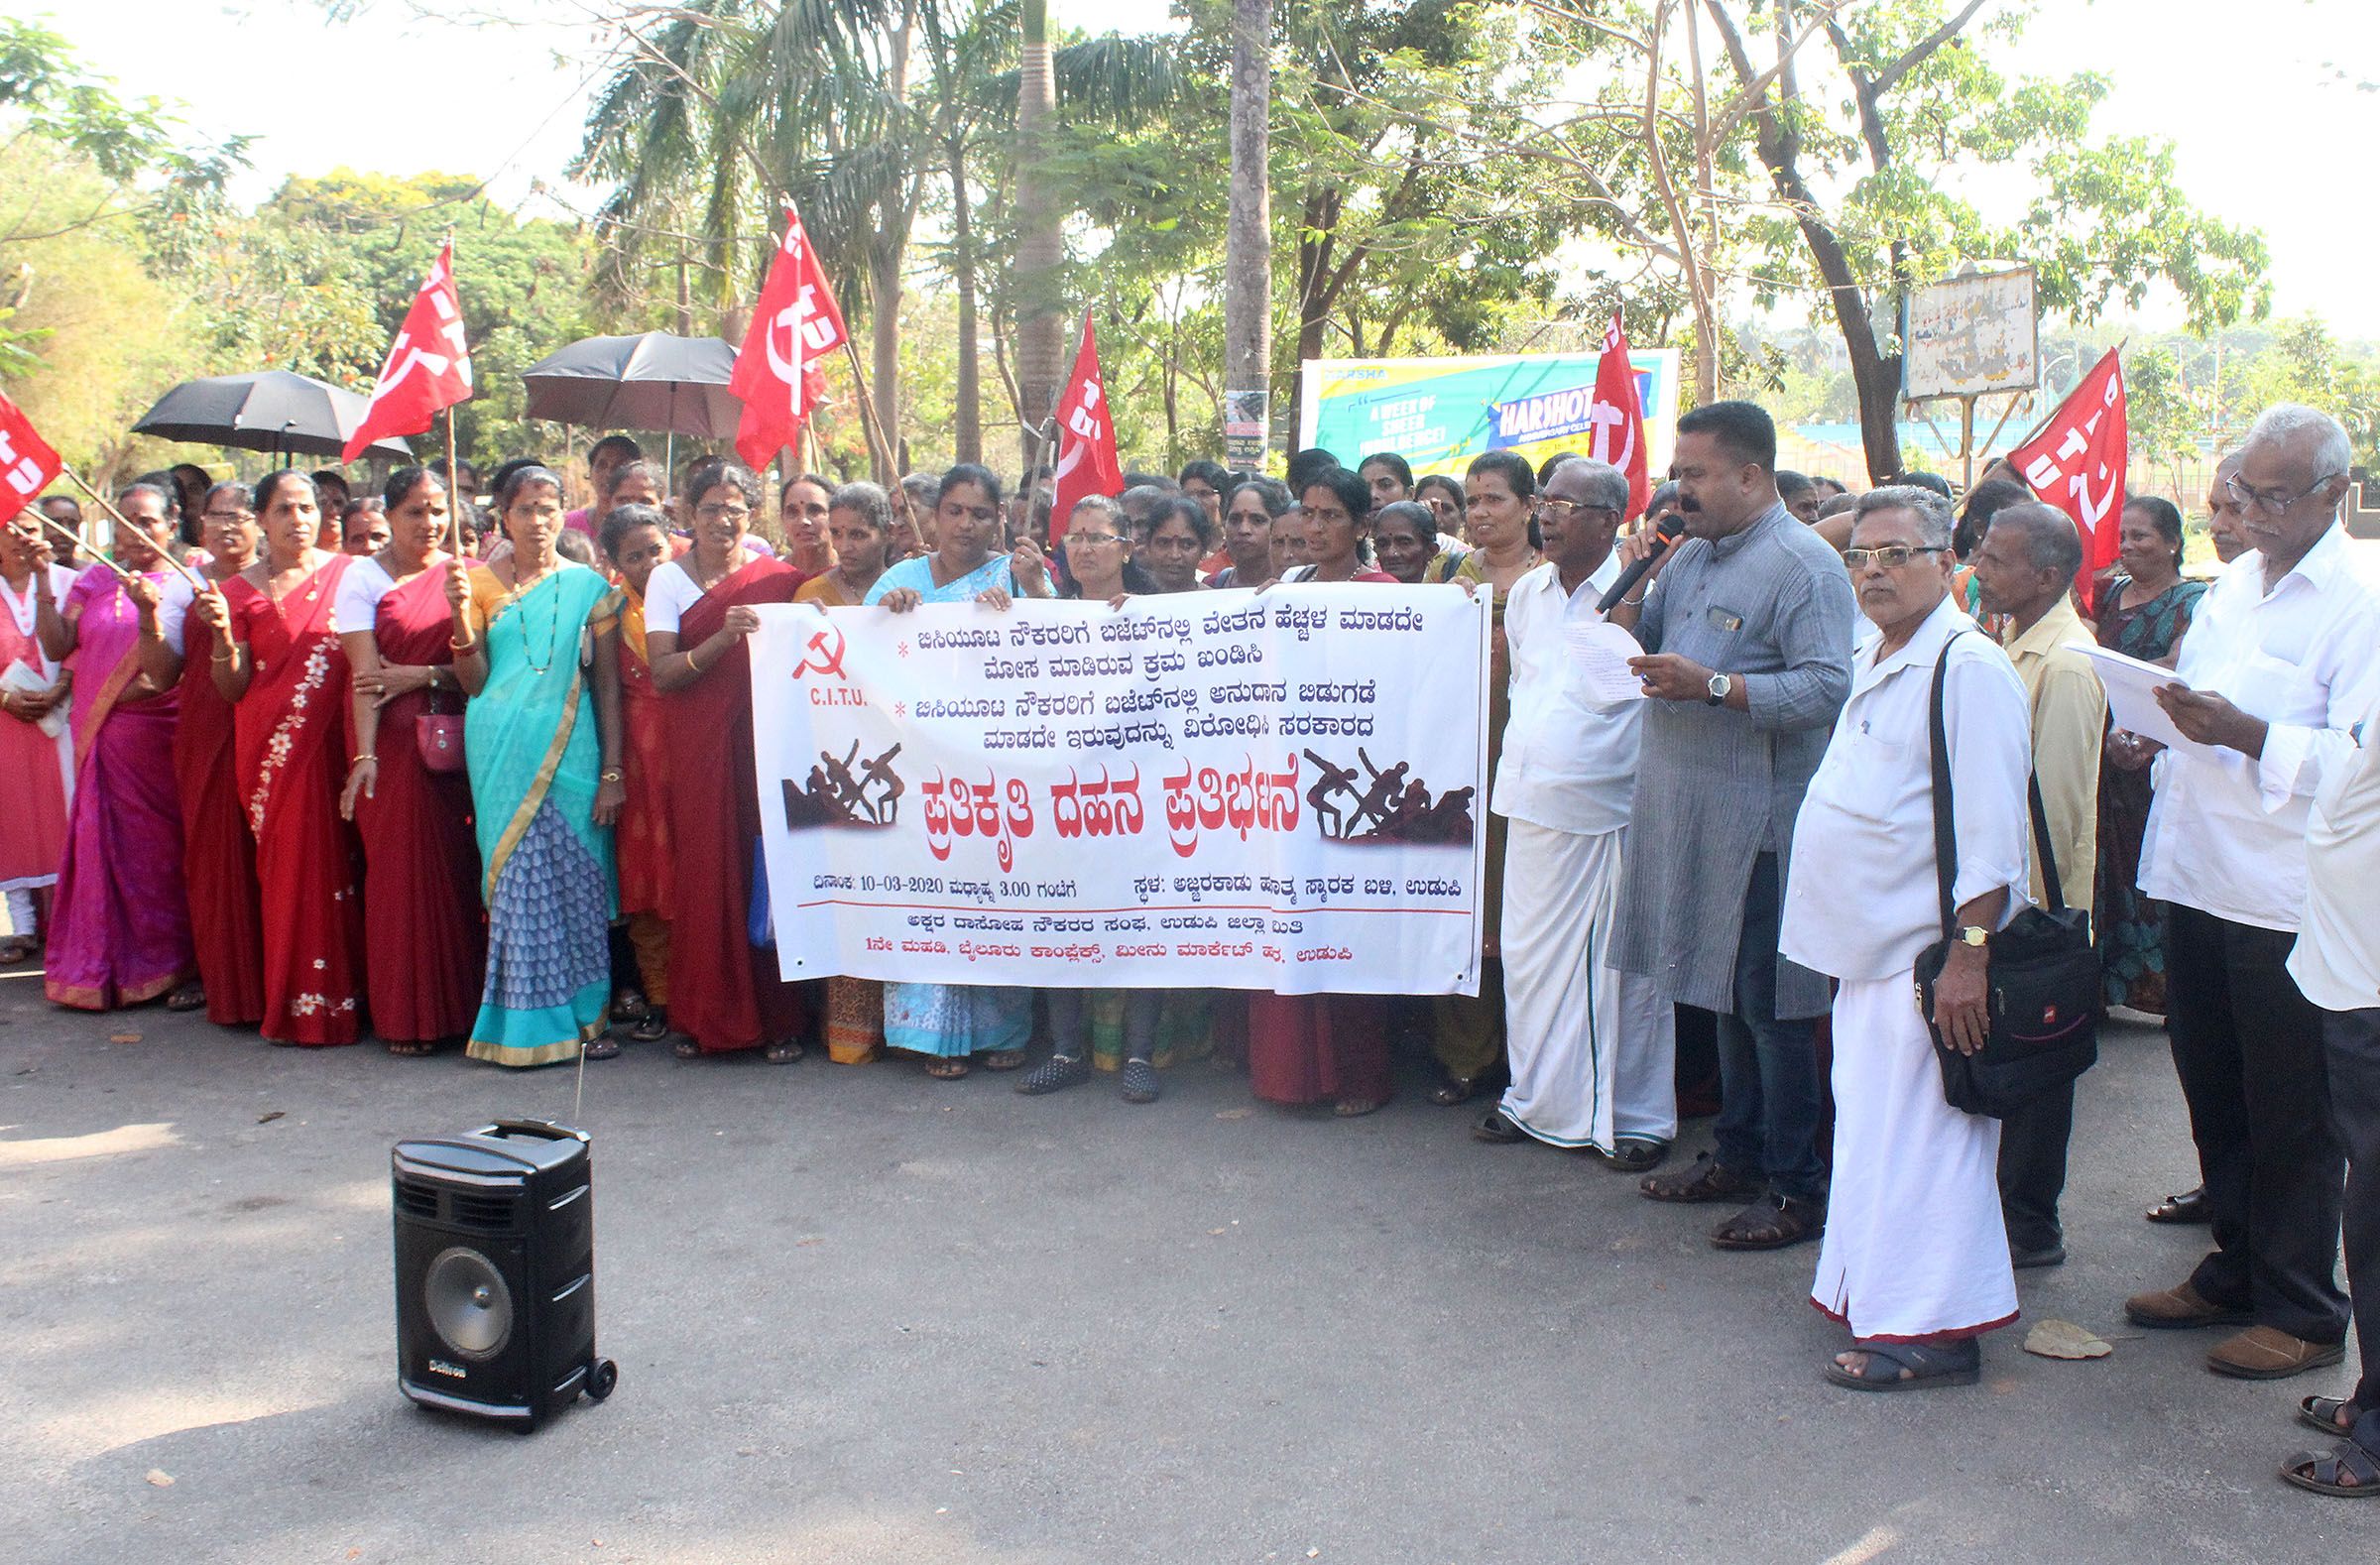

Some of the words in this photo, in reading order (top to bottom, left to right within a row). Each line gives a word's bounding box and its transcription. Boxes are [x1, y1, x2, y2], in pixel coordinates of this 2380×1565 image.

[1325, 368, 1387, 381] HARSHA
[1369, 405, 1379, 422] A
[1380, 398, 1419, 421] WEEK
[1419, 394, 1437, 413] OF
[1380, 414, 1426, 437] SHEER
[917, 629, 1001, 650] ಬಿಸಿಯೂಟ
[1010, 620, 1091, 647] ನೌಕರರಿಗೆ
[1202, 605, 1266, 635] ವೇತನ
[1274, 603, 1328, 642] ಹೆಚ್ಚಳ
[1340, 604, 1424, 632] ಮಾಡದೇ
[984, 655, 1039, 680] ಮೋಸ
[1048, 651, 1133, 678] ಮಾಡಿರುವ
[1142, 646, 1186, 682] ಕ್ರಮ
[1197, 643, 1263, 668] ಖಂಡಿಸಿ
[810, 687, 868, 706] C.I.T.U.
[915, 694, 1006, 718] ಬಿಸಿಯೂಟ
[1015, 690, 1095, 717] ನೌಕರರಿಗೆ
[1210, 678, 1287, 705] ಅನುದಾನ
[1298, 677, 1376, 705] ಬಿಡುಗಡೆ
[983, 724, 1056, 749] ಮಾಡದೇ
[1066, 718, 1174, 751] ಇರುವುದನ್ನು
[1278, 709, 1374, 737] ಸರಕಾರದ
[921, 764, 1034, 874] ಪ್ರತಿಕೃತಿ
[1050, 760, 1144, 839] ದಹನ
[861, 875, 943, 894] 10-03-2020
[1000, 880, 1030, 898] 3.00
[1036, 880, 1077, 898] ಗಂಟೆಗೆ
[1133, 873, 1165, 904] ಸ್ಥಳ:
[1173, 872, 1252, 903] ಅಜ್ಜರಕಾಡು
[1305, 874, 1355, 903] ಸ್ಮಾರಕ
[1405, 876, 1462, 897] ಉಡುಪಿ
[907, 913, 945, 933] ಅಕ್ಷರ
[953, 914, 1023, 931] ದಾಸೋಹ
[1032, 916, 1094, 932] ನೌಕರರ
[1160, 913, 1218, 929] ಉಡುಪಿ
[1227, 916, 1265, 935] ಜಿಲ್ಲಾ
[865, 936, 892, 951] 1ನೇ
[959, 940, 1021, 962] ಬೈಲೂರು
[1116, 941, 1167, 957] ಮೀನು
[1176, 940, 1252, 957] ಮಾರ್ಕೆಟ್
[1296, 944, 1353, 963] ಉಡುಪಿ
